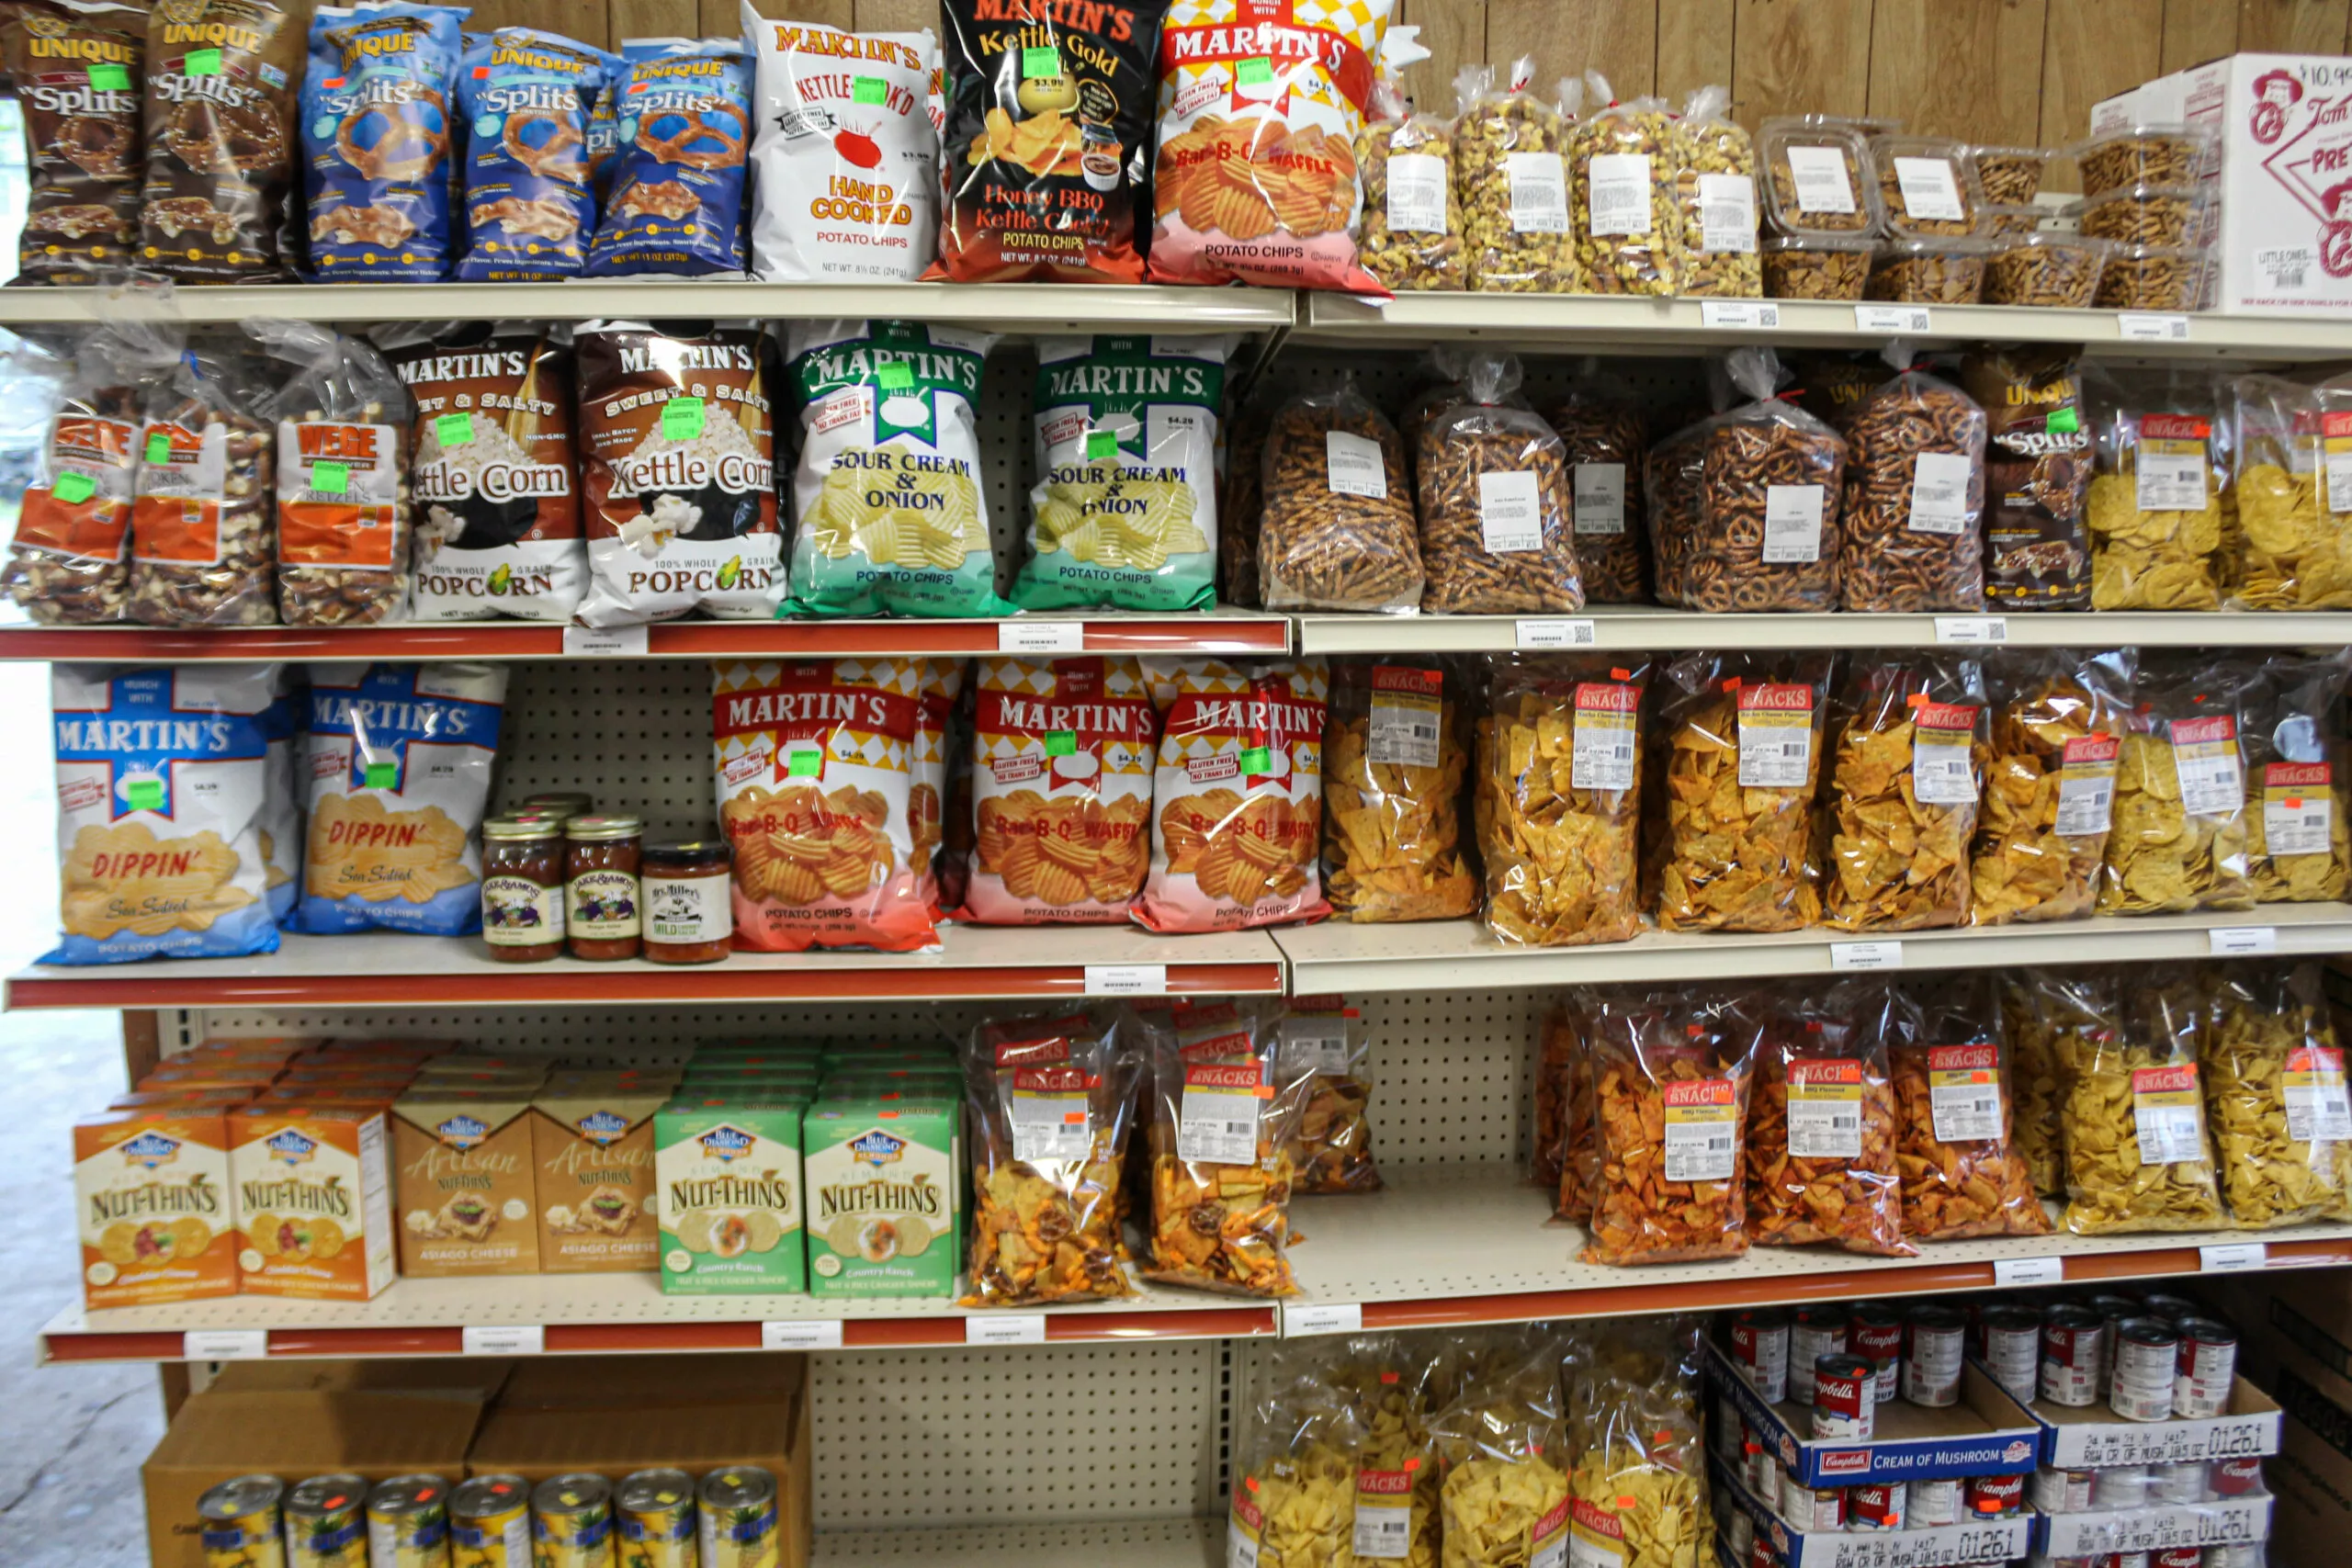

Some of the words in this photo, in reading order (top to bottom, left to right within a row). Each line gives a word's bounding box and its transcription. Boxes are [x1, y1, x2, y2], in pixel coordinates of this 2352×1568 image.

[975, 0, 1135, 42] MARTIN'S
[1253, 6, 1276, 16] WITH
[164, 22, 261, 53] UNIQUE
[1174, 21, 1346, 71] MARTIN'S
[29, 39, 136, 65] UNIQUE
[340, 31, 415, 73] UNIQUE
[774, 25, 921, 71] MARTIN'S
[978, 25, 1060, 56] Kettle
[1067, 34, 1120, 77] Gold
[490, 49, 585, 75] UNIQUE
[632, 62, 723, 81] UNIQUE
[830, 175, 893, 204] HAND
[1059, 188, 1104, 213] BBQ
[810, 198, 911, 226] COOKED
[817, 231, 868, 245] POTATO
[872, 237, 908, 249] CHIPS
[1003, 232, 1048, 248] POTATO
[1053, 235, 1084, 250] CHIPS
[1205, 244, 1259, 257] POTATO
[1262, 245, 1304, 259] CHIPS
[1110, 340, 1133, 352] WITH
[397, 350, 526, 384] MARTIN'S
[1050, 366, 1208, 397] MARTIN'S
[481, 392, 556, 416] SALTY
[605, 386, 678, 417] SWEET
[297, 424, 377, 457] WEGE
[608, 449, 706, 499] Kettle
[831, 452, 893, 471] SOUR
[901, 453, 970, 478] CREAM
[481, 463, 569, 502] Corn
[896, 472, 916, 491] &
[1048, 467, 1103, 485] SOUR
[1113, 467, 1187, 484] CREAM
[1105, 483, 1123, 497] &
[865, 490, 946, 511] ONION
[655, 559, 680, 569] 100%
[682, 558, 717, 569] WHOLE
[417, 564, 552, 596] POPCORN
[628, 555, 772, 593] POPCORN
[856, 570, 910, 583] POTATO
[915, 570, 955, 585] CHIPS
[1058, 566, 1110, 581] POTATO
[1114, 570, 1152, 585] CHIPS
[1581, 694, 1634, 707] SNACKS
[1744, 690, 1806, 707] SNACKS
[312, 696, 470, 735] MARTIN'S
[729, 693, 888, 727] MARTIN'S
[999, 700, 1152, 735] MARTIN'S
[1194, 700, 1326, 735] MARTIN'S
[1923, 710, 1972, 727] SNACKS
[57, 720, 232, 752] MARTIN'S
[2065, 741, 2115, 761] SNACKS
[1188, 760, 1215, 772] GLUTEN
[1216, 756, 1236, 767] FREE
[1202, 771, 1221, 781] TRANS
[2268, 767, 2325, 784] SNACKS
[328, 820, 426, 848] DIPPIN'
[92, 850, 201, 879] DIPPIN'
[765, 908, 811, 919] POTATO
[815, 907, 853, 918] CHIPS
[1023, 908, 1070, 918] POTATO
[1073, 908, 1110, 919] CHIPS
[1257, 905, 1290, 918] CHIPS
[653, 924, 676, 935] MILD
[1935, 1050, 1992, 1068] SNACKS
[1191, 1069, 1258, 1085] SNACKS
[2136, 1072, 2189, 1090] SNACKS
[704, 1137, 749, 1147] DIAMOND
[715, 1130, 736, 1140] BLUE
[865, 1135, 887, 1145] BLUE
[854, 1142, 900, 1153] DIAMOND
[670, 1178, 787, 1213] NUT-THINS
[820, 1182, 937, 1218] NUT-THINS
[420, 1249, 468, 1260] ASIAGO
[470, 1247, 518, 1258] CHEESE
[560, 1244, 607, 1255] ASIAGO
[610, 1243, 657, 1254] CHEESE
[1874, 1455, 1913, 1469] CREAM
[1917, 1454, 1932, 1466] OF
[1935, 1450, 1999, 1465] MUSHROOM
[1576, 1505, 1622, 1536] SNACKS
